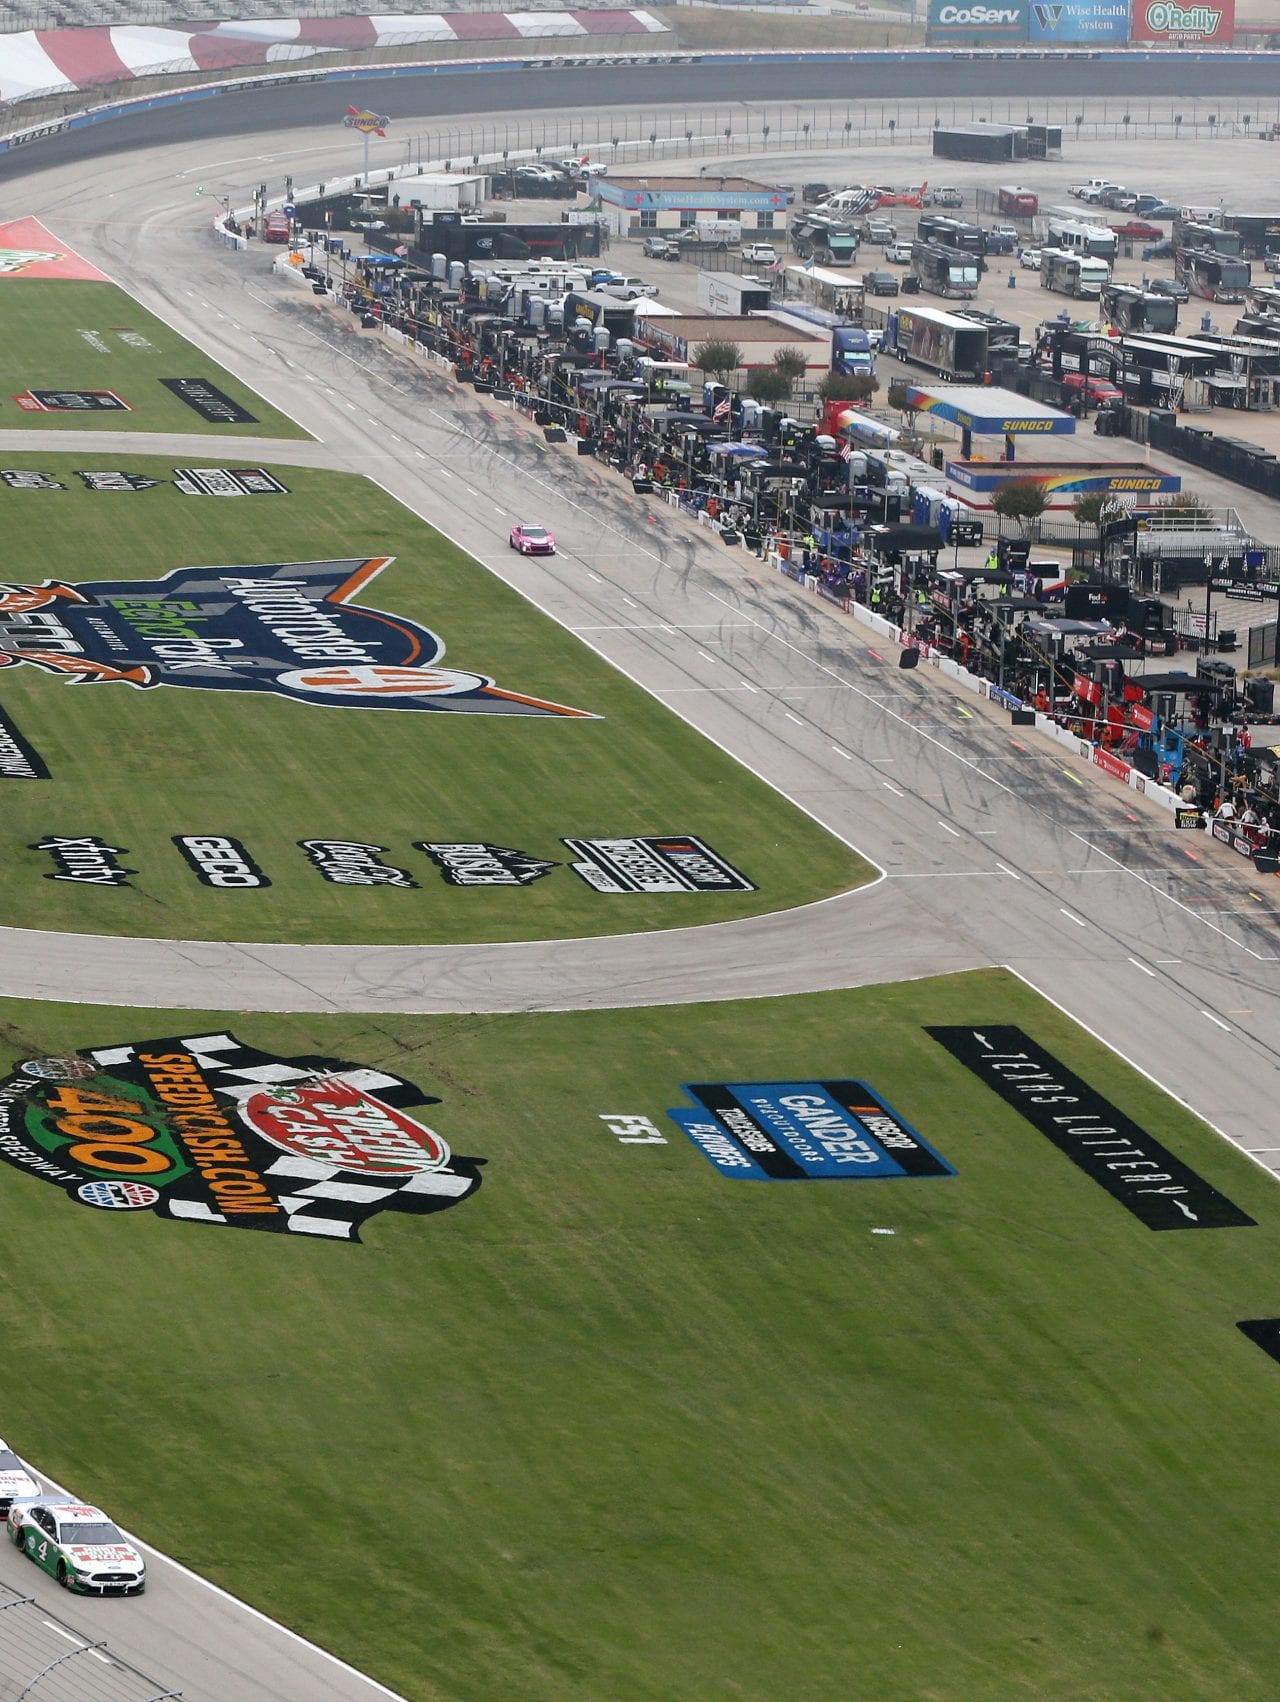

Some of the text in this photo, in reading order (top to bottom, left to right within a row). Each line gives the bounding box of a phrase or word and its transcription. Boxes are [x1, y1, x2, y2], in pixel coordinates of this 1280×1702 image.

[939, 6, 1019, 24] CoServ
[1067, 5, 1126, 18] Wise Health
[1079, 19, 1113, 31] System
[1148, 1, 1220, 34] O'Reilly
[572, 58, 650, 66] TEXAS
[19, 125, 59, 143] TEXAS
[345, 117, 390, 127] SUNOCO
[664, 192, 768, 205] WiseHealthSystem.com
[1002, 420, 1053, 431] SUNOCO
[1108, 479, 1162, 490] SUNOCO
[220, 577, 383, 664] Autotrader
[38, 837, 128, 886] xfinity
[182, 836, 261, 888] GEICO
[423, 843, 523, 885] BUSCH
[622, 859, 677, 885] SERIES
[667, 855, 731, 884] NASCAR
[138, 1052, 279, 1214] SPEEDYCASH.COM
[266, 1106, 365, 1165] CASH
[599, 1114, 668, 1146] FS1
[778, 1094, 881, 1167] GANDER
[858, 1113, 920, 1151] NASCAR
[981, 1053, 1189, 1197] TEXAS LOTTERY
[683, 1121, 752, 1170] PLAYOFFS
[38, 1540, 49, 1562] 4
